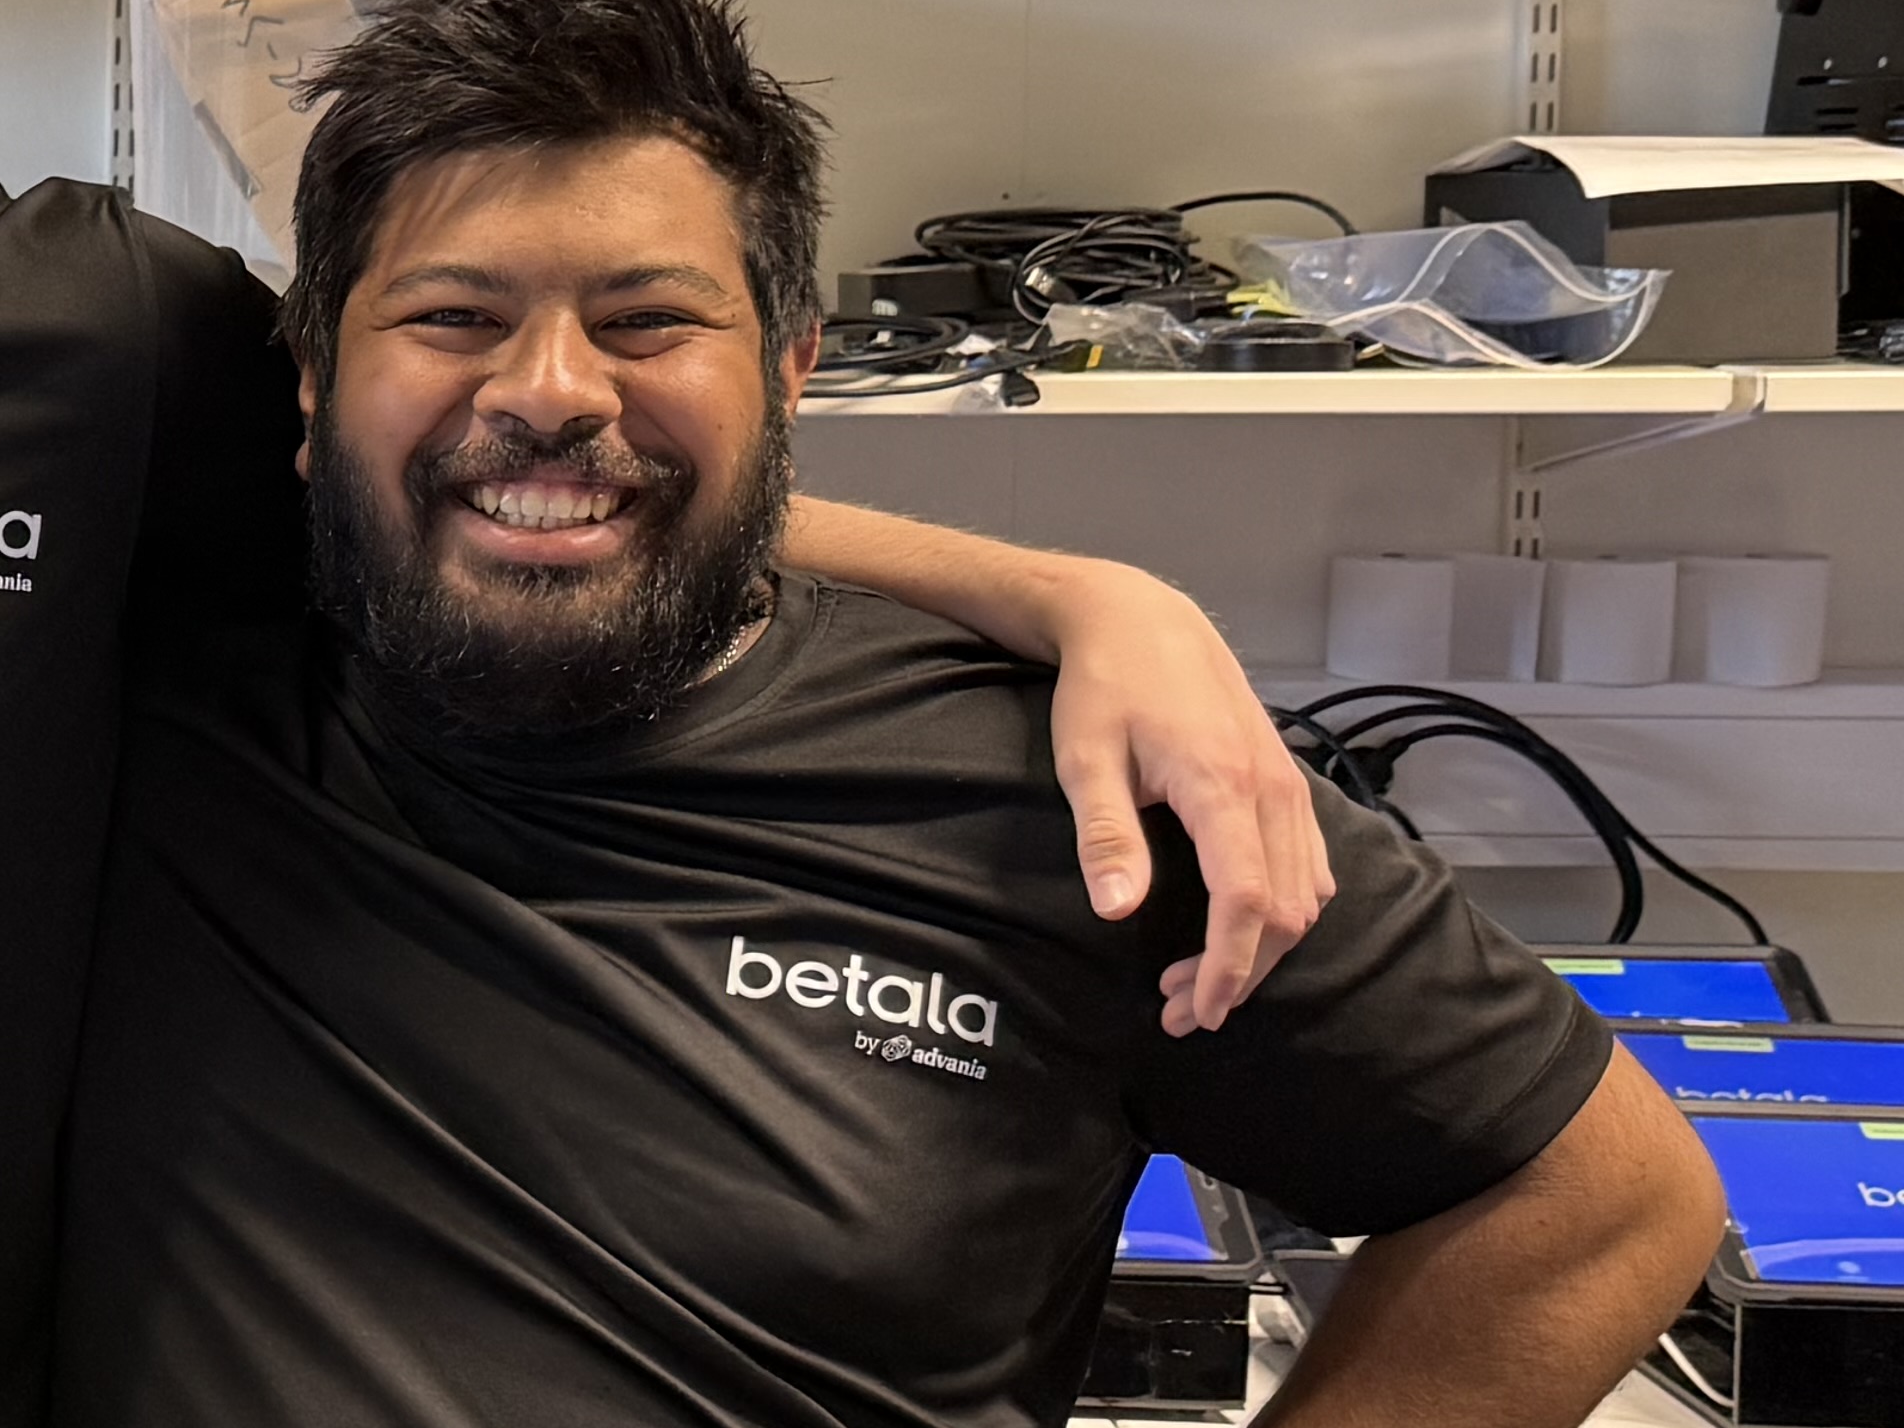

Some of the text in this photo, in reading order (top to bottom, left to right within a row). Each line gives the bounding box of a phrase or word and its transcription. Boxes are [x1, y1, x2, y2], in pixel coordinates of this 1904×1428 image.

[725, 935, 998, 1047] betala
[854, 1030, 988, 1081] by advania
